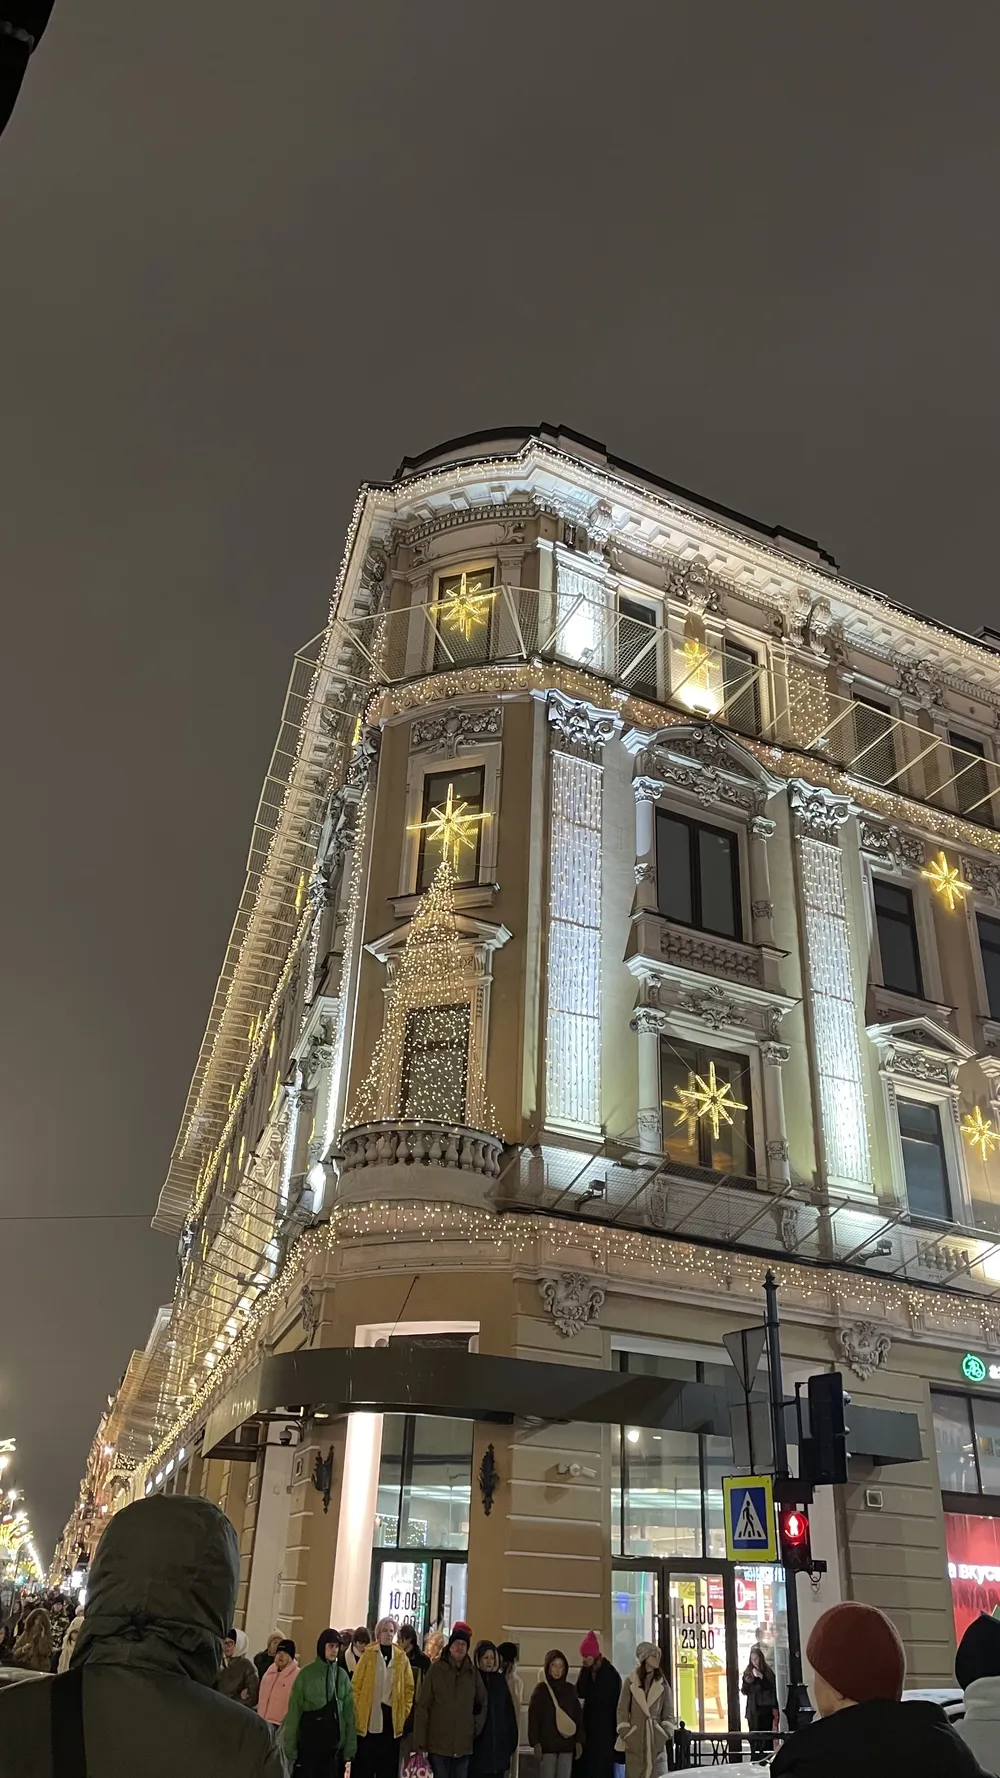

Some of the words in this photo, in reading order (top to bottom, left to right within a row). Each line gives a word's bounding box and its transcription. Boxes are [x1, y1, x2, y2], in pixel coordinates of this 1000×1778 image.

[390, 1591, 417, 1611] 10:00
[681, 1604, 714, 1625] 10:00
[681, 1629, 715, 1650] 23:00
